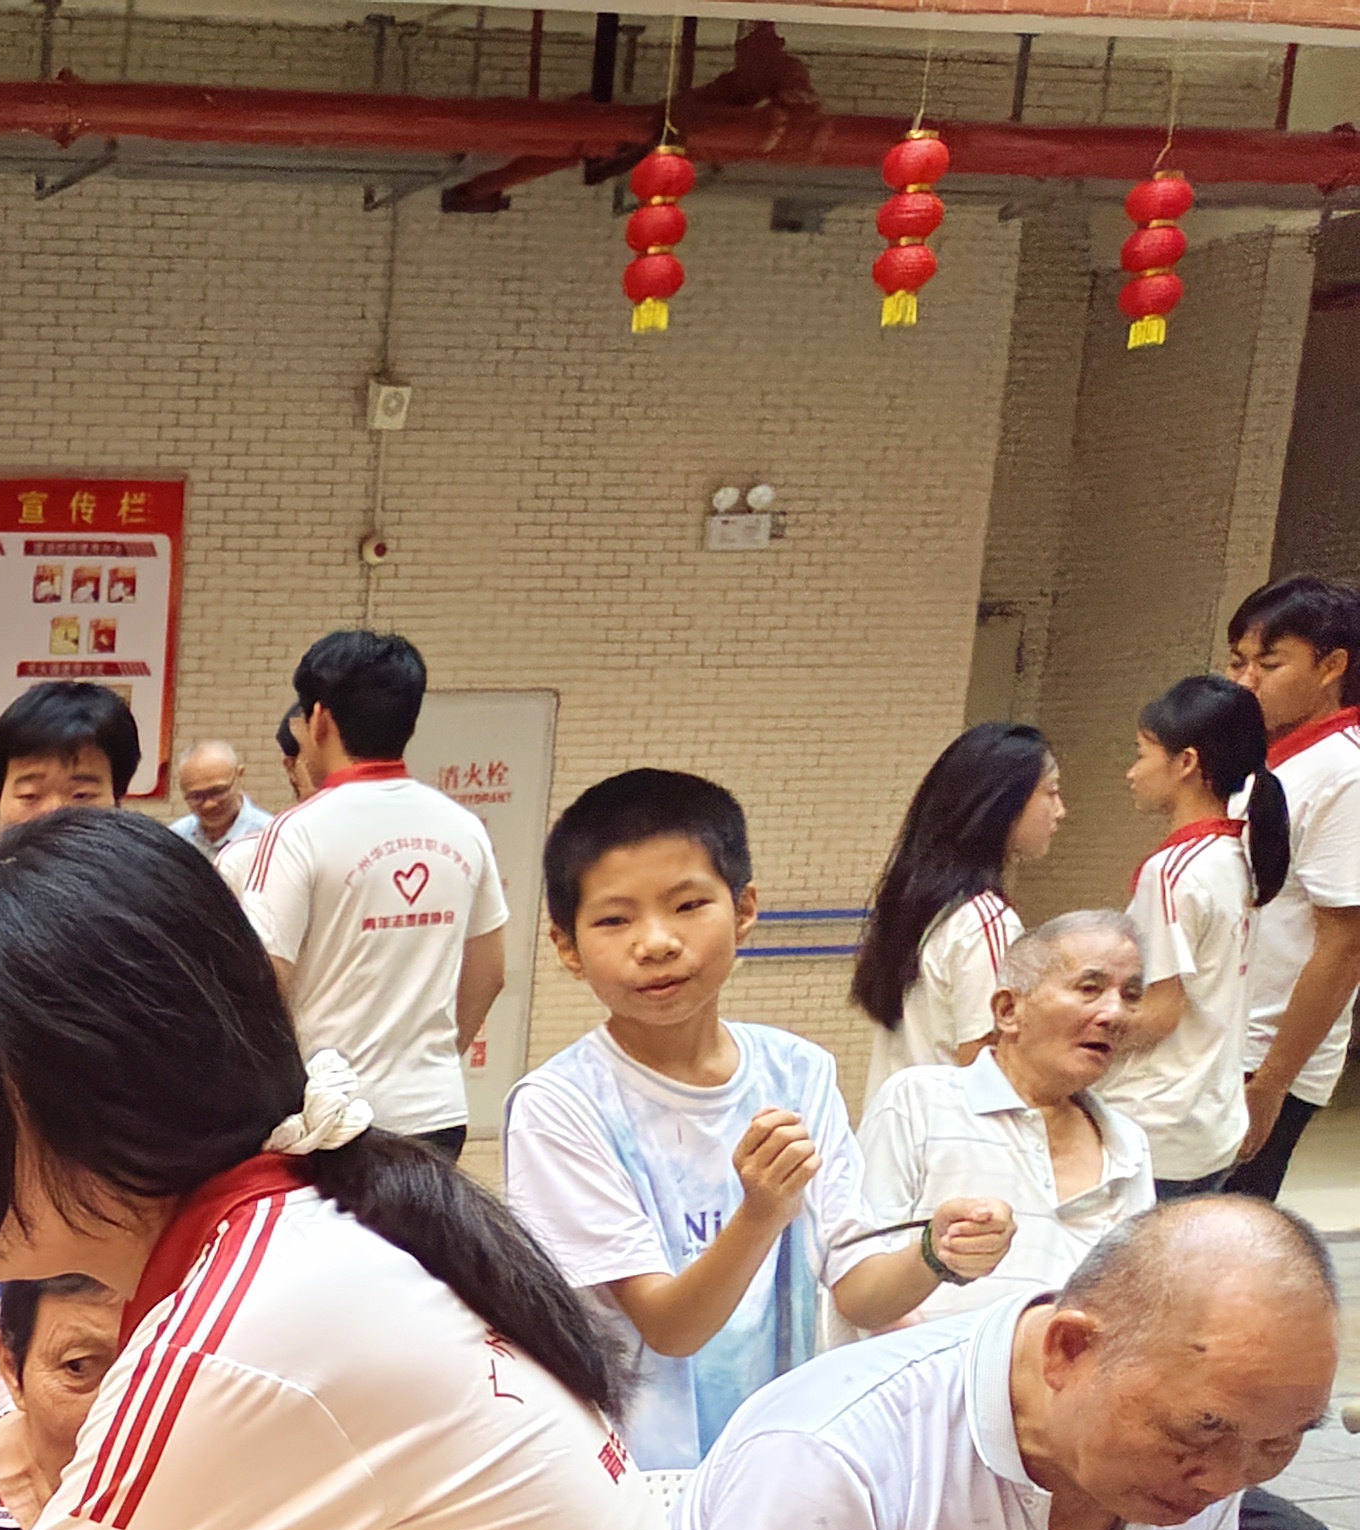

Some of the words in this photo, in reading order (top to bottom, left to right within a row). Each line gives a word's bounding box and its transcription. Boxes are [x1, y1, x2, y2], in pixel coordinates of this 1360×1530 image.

[437, 760, 510, 790] 消火栓
[684, 1210, 722, 1243] Ni
